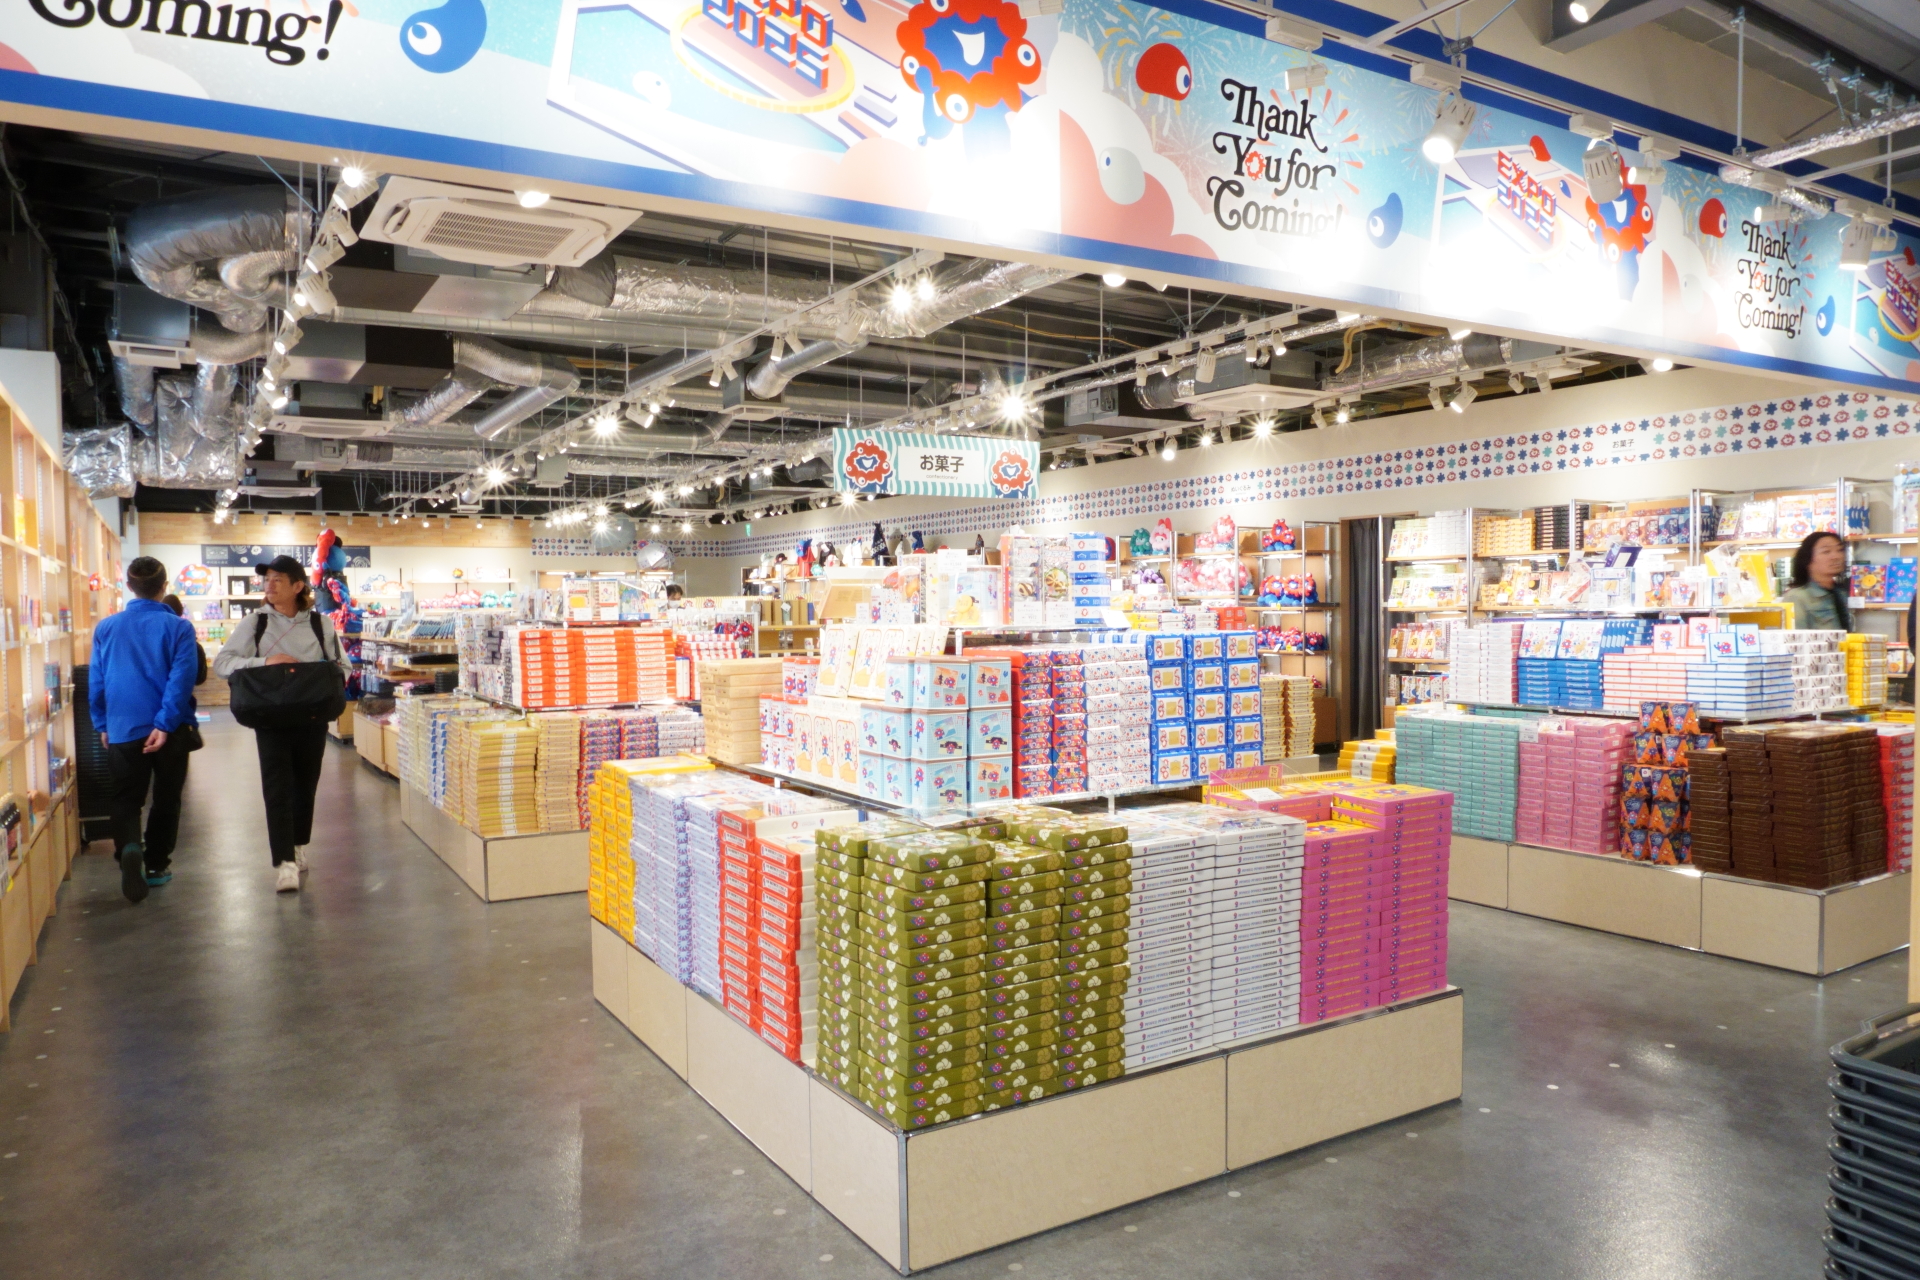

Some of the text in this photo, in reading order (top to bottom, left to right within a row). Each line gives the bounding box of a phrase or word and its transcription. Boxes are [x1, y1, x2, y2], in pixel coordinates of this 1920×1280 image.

[1221, 78, 1329, 153] Thank
[1213, 131, 1337, 197] You for
[1497, 150, 1556, 218] EXPO
[1497, 176, 1555, 246] 2025
[1741, 220, 1797, 269] Thank
[1737, 258, 1801, 302] You for
[1734, 291, 1804, 340] Coming!
[920, 454, 965, 473] お菓子
[1612, 438, 1635, 449] お菓子
